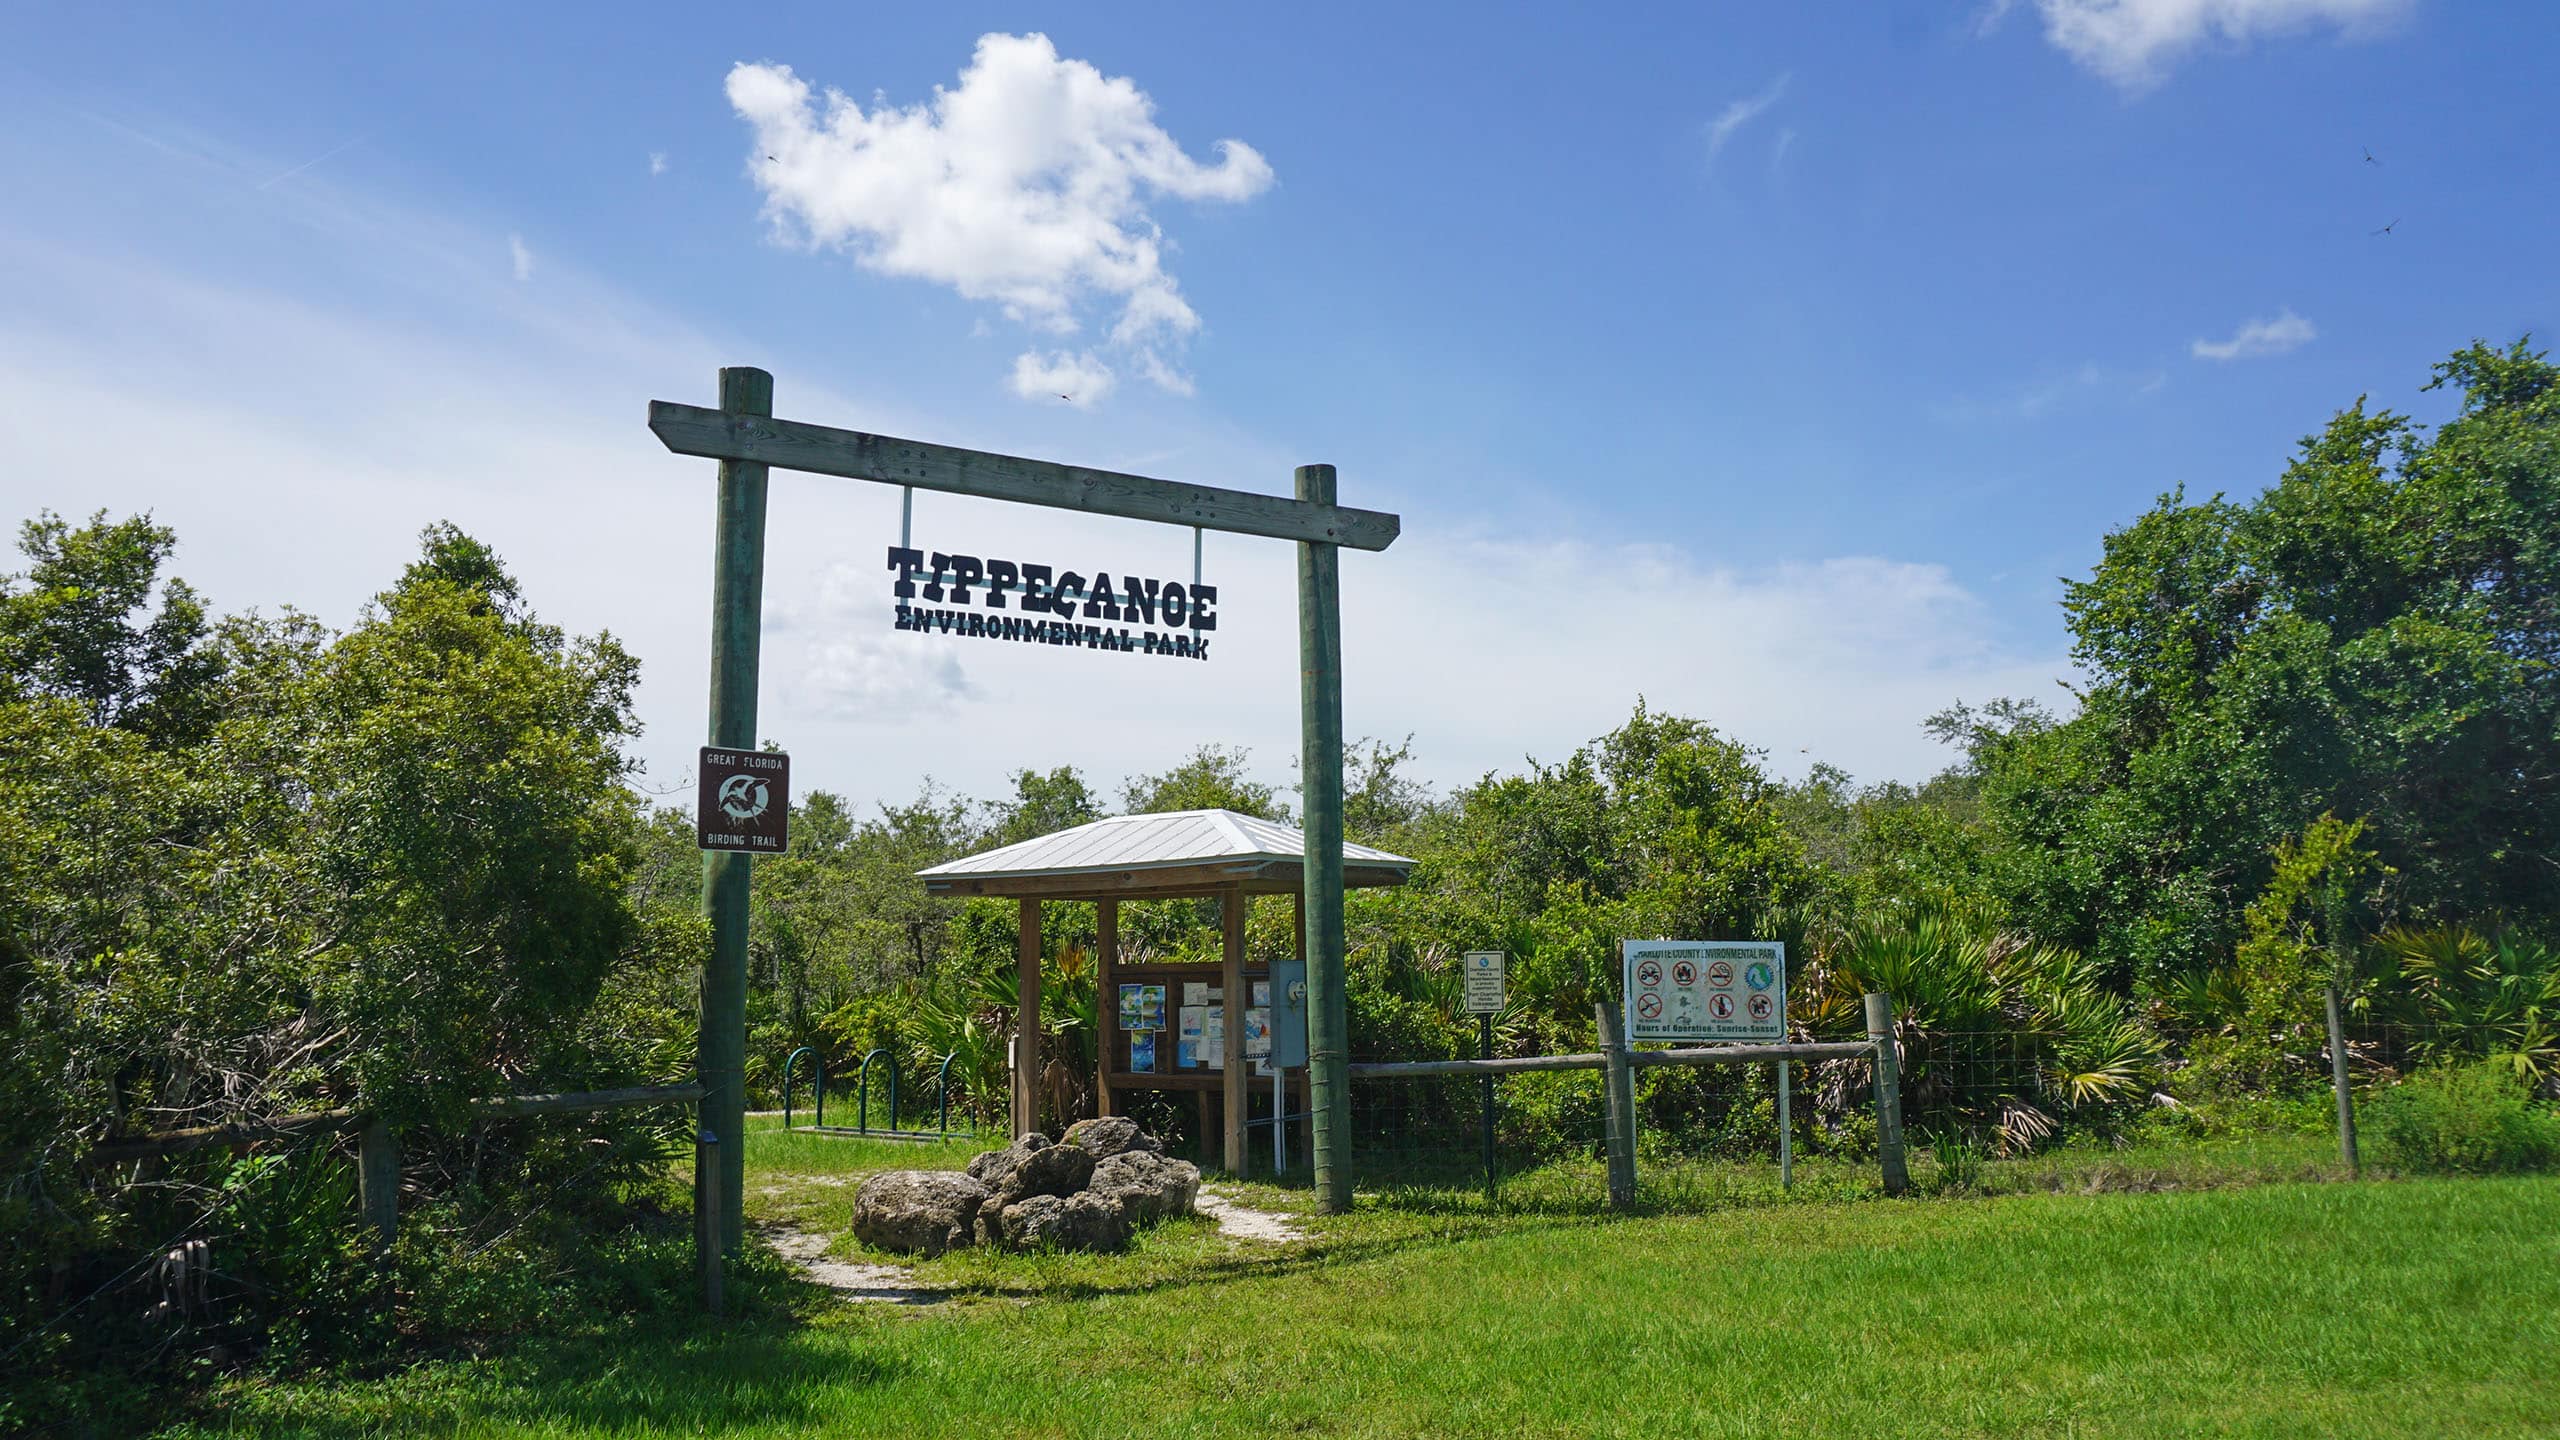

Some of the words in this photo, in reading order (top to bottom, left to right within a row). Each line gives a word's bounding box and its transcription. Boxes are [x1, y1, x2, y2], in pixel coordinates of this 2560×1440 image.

[887, 546, 1217, 631] TIPPECANOE
[894, 604, 1134, 652] ENVIRONMENTAL
[1143, 631, 1209, 661] PARK
[707, 754, 736, 766] GREAT
[743, 757, 783, 770] FLORIDA
[707, 833, 745, 845] BIRDING
[752, 835, 778, 847] TRAIL
[1671, 948, 1700, 958] COUNTY
[1759, 949, 1777, 959] PARK
[1636, 1024, 1659, 1032] Hours
[1662, 1024, 1670, 1032] of
